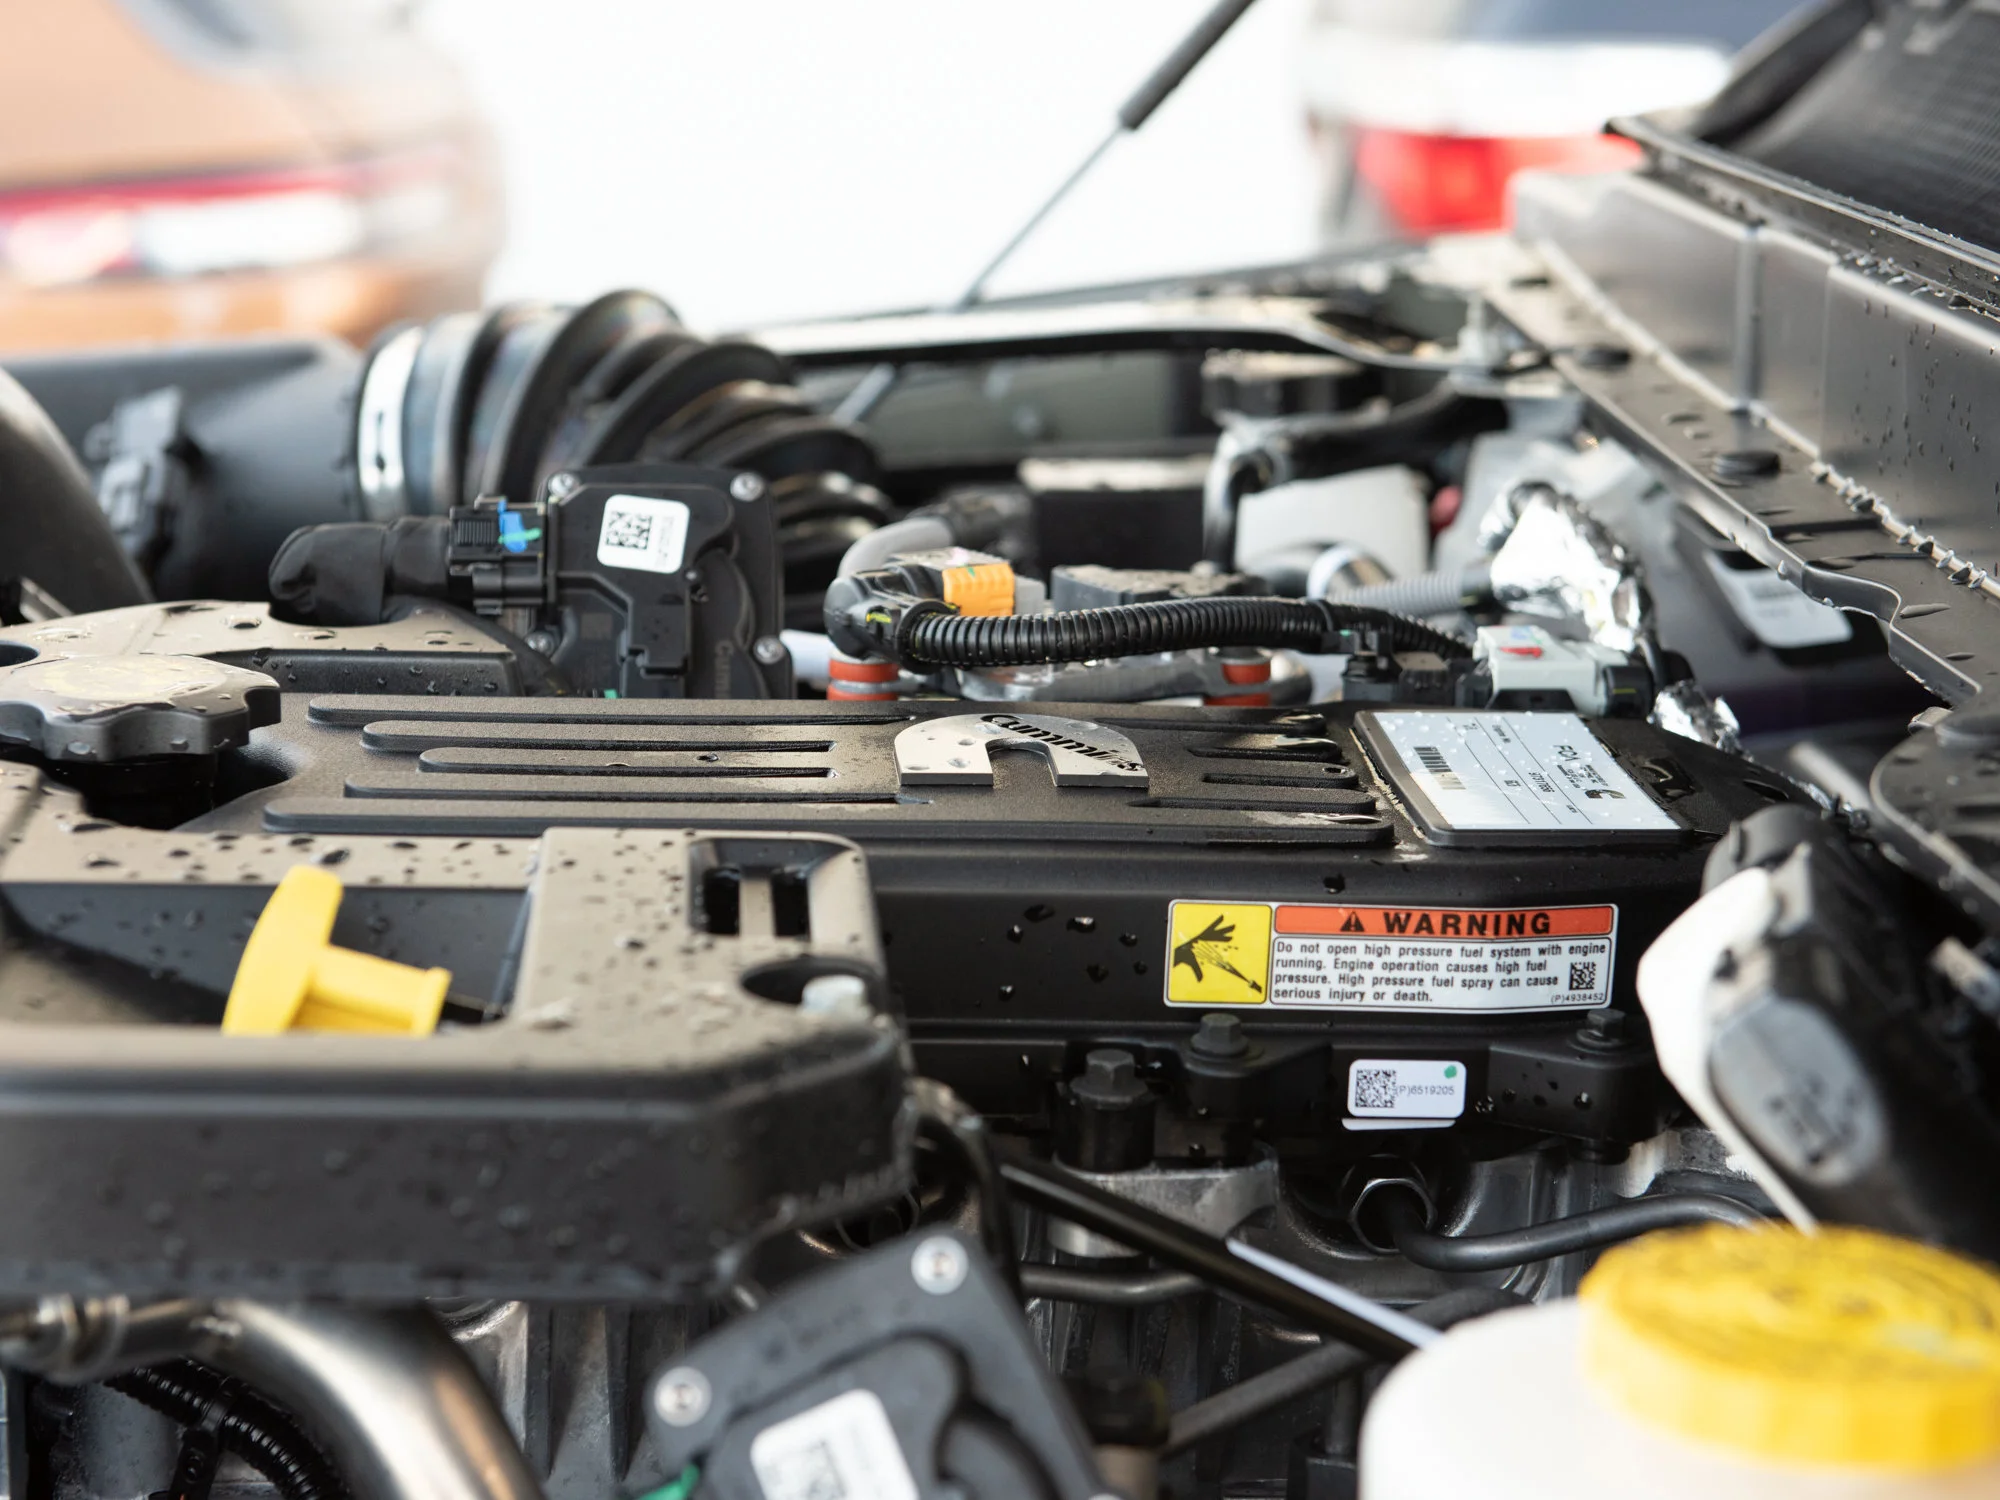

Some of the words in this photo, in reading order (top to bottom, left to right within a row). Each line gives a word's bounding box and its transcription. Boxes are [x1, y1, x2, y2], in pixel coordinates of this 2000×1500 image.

[980, 714, 1144, 772] Cummins
[1383, 912, 1551, 935] WARNING
[1276, 941, 1292, 953] Do
[1300, 942, 1320, 953] not
[1327, 946, 1356, 957] open
[1364, 944, 1391, 956] high
[1398, 946, 1452, 957] pressure
[1460, 946, 1483, 958] fuel
[1490, 947, 1531, 960] system
[1538, 945, 1562, 955] with
[1568, 944, 1606, 957] engine
[1275, 958, 1326, 971] running.
[1334, 958, 1374, 971] Engine
[1382, 961, 1439, 972] operation
[1446, 962, 1488, 973] causes
[1495, 962, 1519, 974] high
[1526, 960, 1547, 971] fuel
[1275, 974, 1331, 986] pressure.
[1338, 974, 1364, 986] High
[1372, 976, 1424, 987] pressure
[1432, 976, 1454, 987] fuel
[1461, 978, 1493, 990] spray
[1500, 978, 1520, 987] can
[1526, 976, 1558, 986] cause
[1274, 988, 1320, 998] serious
[1329, 989, 1365, 1002] injury
[1373, 991, 1386, 1000] or
[1393, 990, 1433, 1002] death.
[1551, 993, 1604, 1004] (P)4938452
